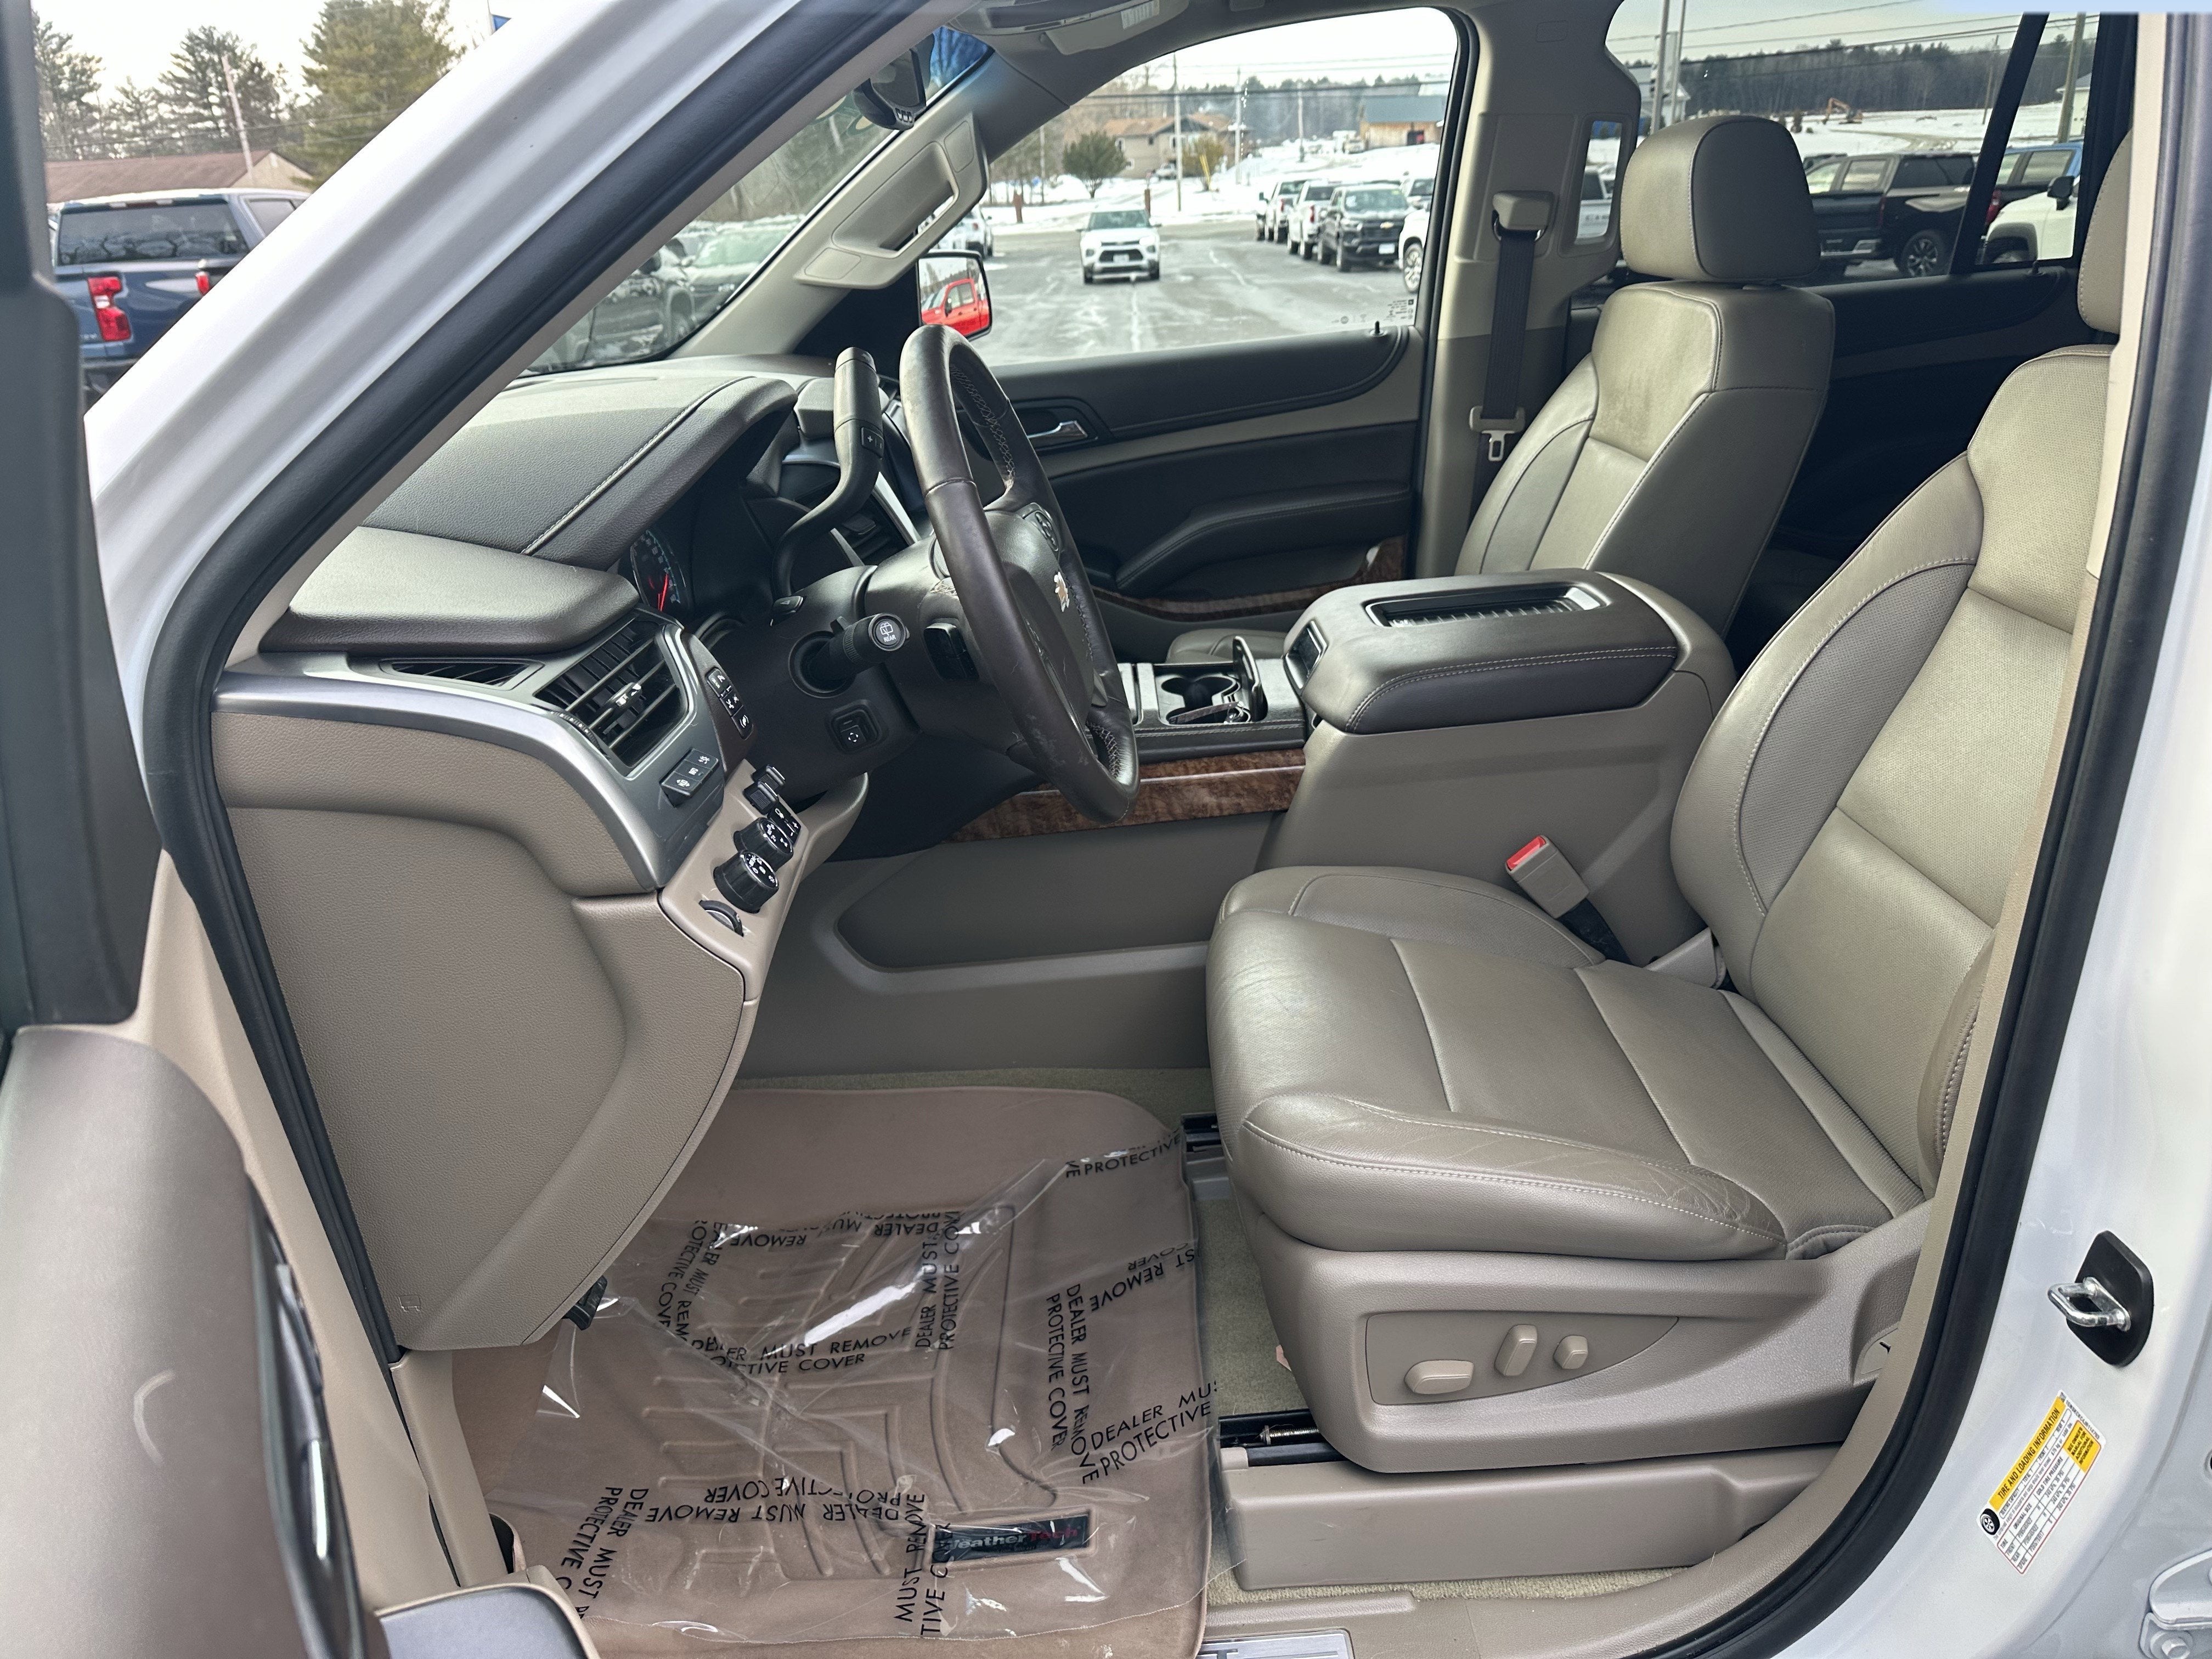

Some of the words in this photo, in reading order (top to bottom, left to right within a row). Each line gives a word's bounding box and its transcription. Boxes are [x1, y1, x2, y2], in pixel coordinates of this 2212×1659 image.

[883, 634, 896, 642] REAR
[1085, 1133, 1180, 1175] PROTECTIVE
[668, 1220, 707, 1279] OTECTIVE
[874, 1221, 938, 1237] DEALER
[922, 1242, 938, 1294] MUST
[1090, 1262, 1164, 1312] REMOVE
[675, 1300, 692, 1341] REM
[915, 1304, 936, 1348] DEALER
[939, 1264, 960, 1350] PROTECTIVE
[1067, 1284, 1087, 1345] DEALER
[760, 1344, 819, 1361] MUST
[830, 1327, 912, 1354] REMOVE
[799, 1353, 865, 1371] COVER
[1046, 1293, 1065, 1383] PROTECTIVE
[1071, 1352, 1089, 1395] MUST
[1048, 1387, 1068, 1451] COVER
[1091, 1405, 1163, 1450] DEALER
[1179, 1380, 1217, 1408] MU
[1100, 1401, 1211, 1476] PROTECTIVE
[1071, 1404, 1099, 1484] REMOVE
[1997, 1483, 2010, 1499] TIRE
[2007, 1471, 2019, 1487] AND
[2016, 1446, 2036, 1475] LOADING
[2033, 1407, 2060, 1449] INFORMATION
[607, 1488, 649, 1537] DEALER
[646, 1504, 740, 1522] REMOVE
[704, 1481, 769, 1502] COVER
[751, 1503, 805, 1522] MUST
[561, 1487, 623, 1569] PROTECTIVE
[906, 1494, 927, 1553] REMOVE
[1999, 1538, 2008, 1550] TIRE
[579, 1547, 617, 1598] MUST
[894, 1568, 922, 1622] MUST
